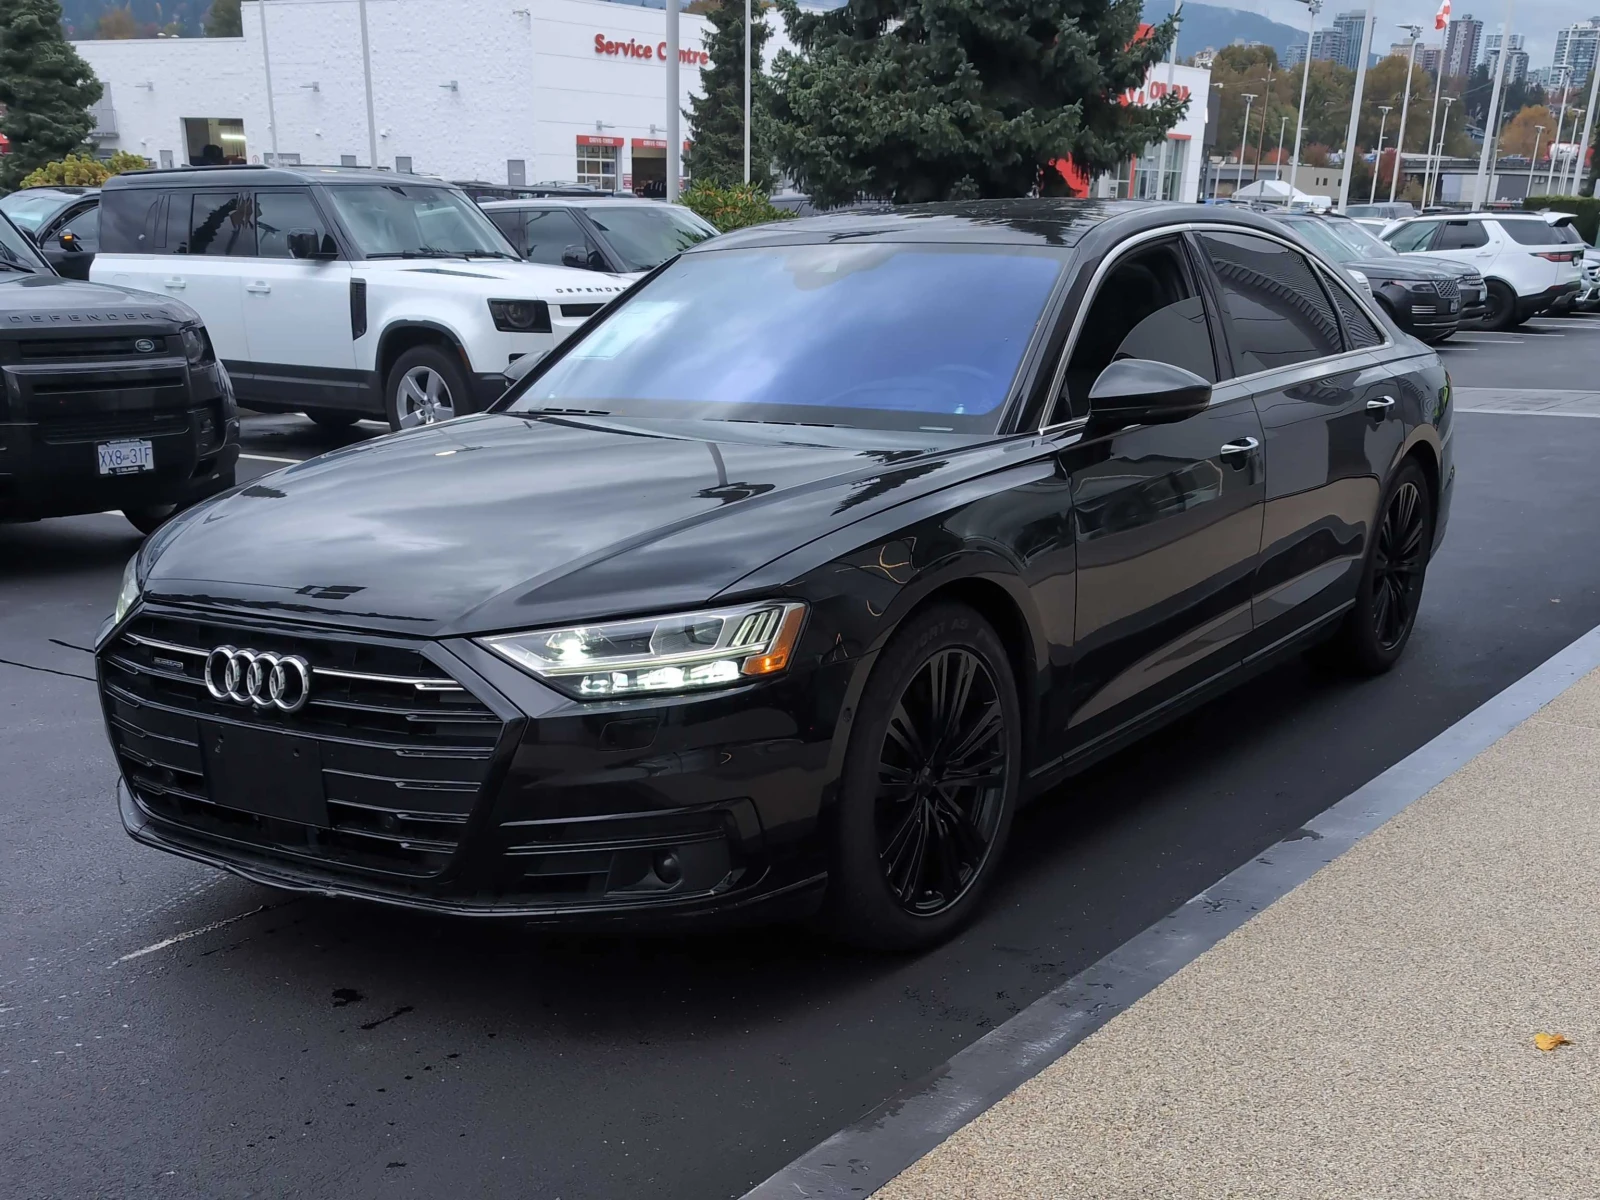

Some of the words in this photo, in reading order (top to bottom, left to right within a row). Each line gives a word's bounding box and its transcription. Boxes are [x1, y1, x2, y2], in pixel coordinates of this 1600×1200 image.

[594, 33, 652, 59] Service
[657, 42, 708, 65] Cntre
[8, 312, 153, 323] DEFENDER
